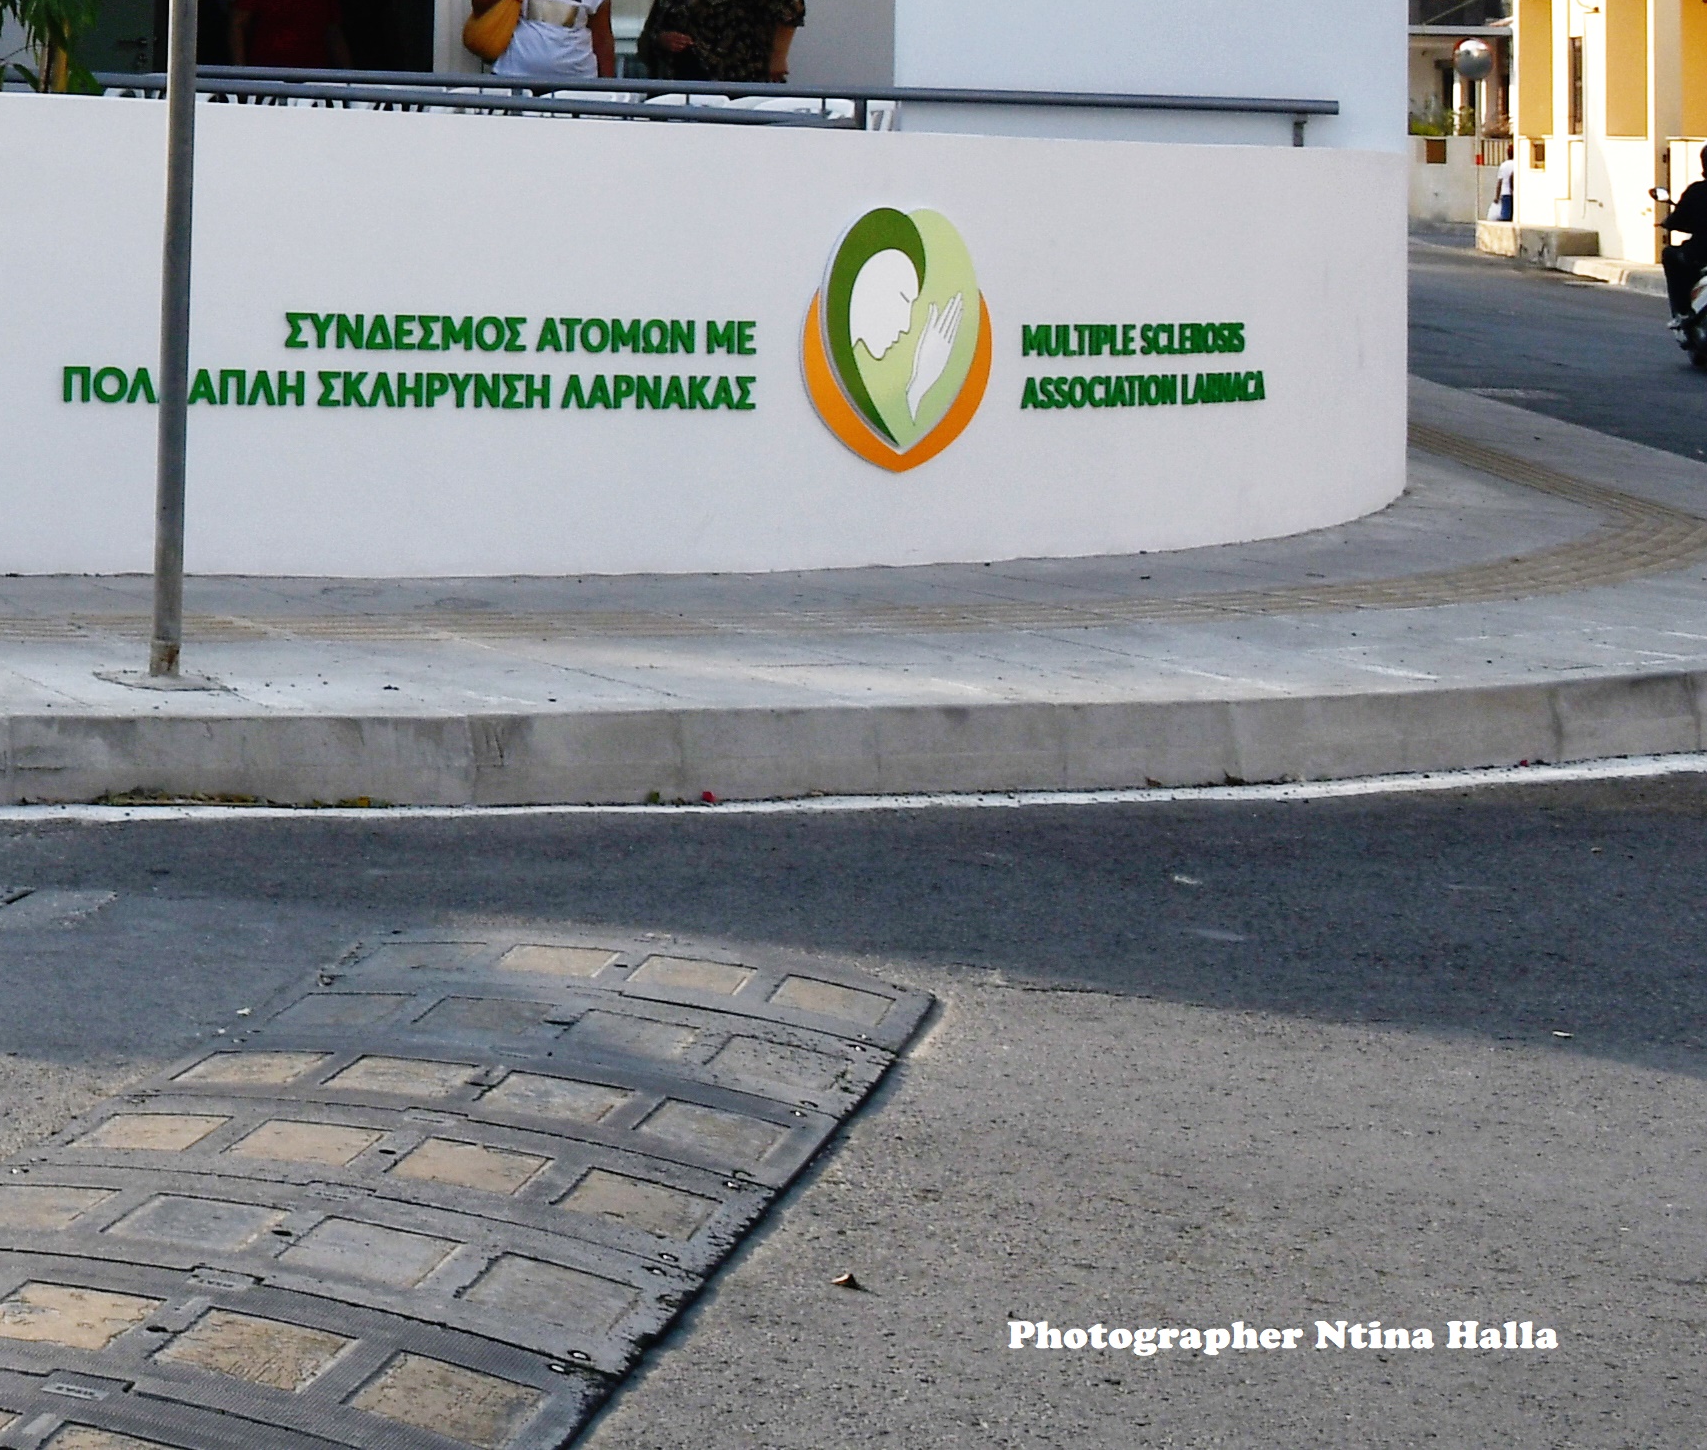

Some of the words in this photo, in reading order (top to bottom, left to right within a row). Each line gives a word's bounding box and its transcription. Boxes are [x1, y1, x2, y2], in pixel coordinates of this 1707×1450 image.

[284, 312, 527, 353] ΣΥΝΔΕΣΜΟΣ
[536, 317, 695, 355] ΑΤΟΜΩΝ
[706, 320, 756, 356] ΜΕ
[1022, 324, 1136, 357] MULTIPLE
[1140, 322, 1245, 356] SCLEROSIS
[63, 366, 305, 406] ΠΟΛΑΠΛΗ
[317, 371, 550, 409] ΣΚΛΗΡΥΝΣΗ
[560, 374, 756, 411] ΛΑΡΝΑΚΑΣ
[1020, 374, 1177, 410] ASSOCIATION
[1181, 370, 1265, 406] LARNACA
